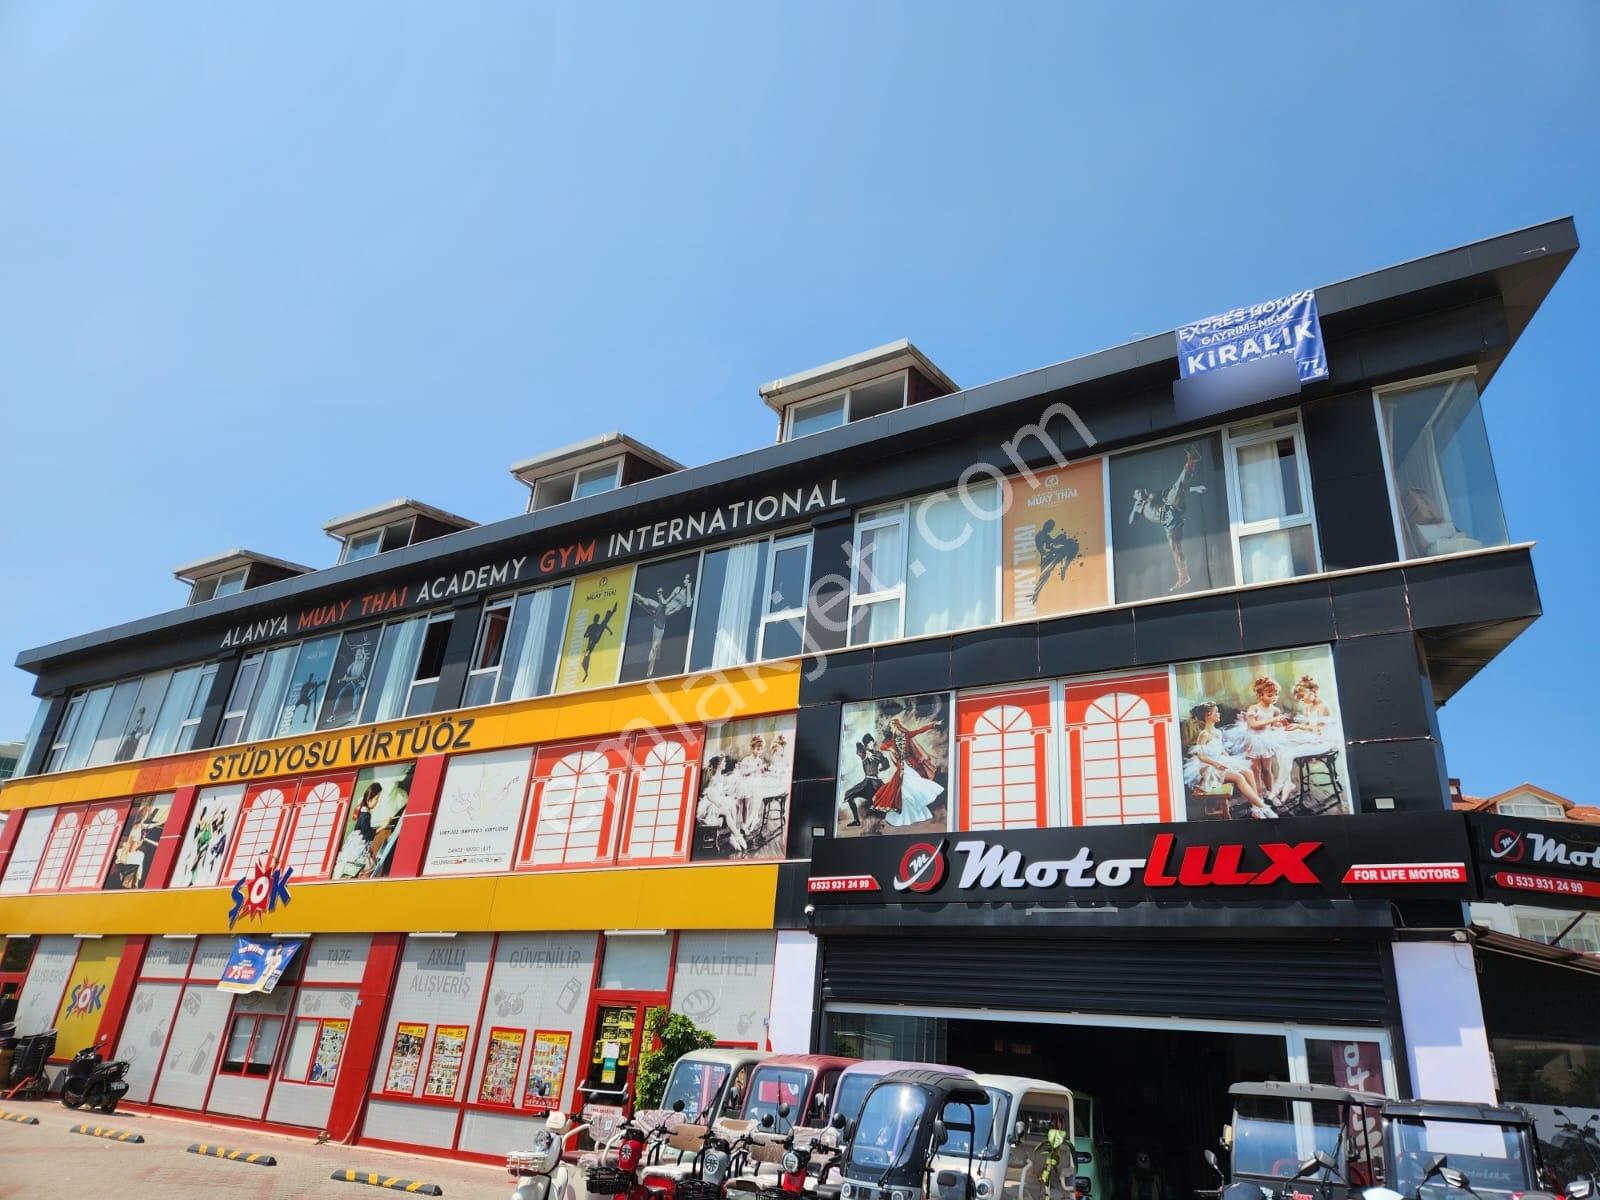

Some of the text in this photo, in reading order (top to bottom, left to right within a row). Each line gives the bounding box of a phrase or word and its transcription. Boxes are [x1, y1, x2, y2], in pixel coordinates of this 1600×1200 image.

[1179, 308, 1245, 342] EXPRES
[220, 479, 847, 649] ALANYA MUAY THAI ACADEMY GYM INTERNATIONAL
[208, 717, 476, 781] STÜDYOSU VİRTÜÖZ
[955, 833, 1323, 888] Motolux
[811, 879, 869, 890] 0533 931 24 99
[1353, 868, 1460, 881] FOR LIFE MOTORS
[1506, 874, 1584, 893] 0 533 931 24 99
[327, 948, 352, 967] TAZE
[427, 947, 465, 967] AKILLI
[509, 946, 581, 969] GÜVENİLİR
[689, 951, 760, 977] KALİTELİ
[409, 972, 471, 998] ALIŞVERİŞ
